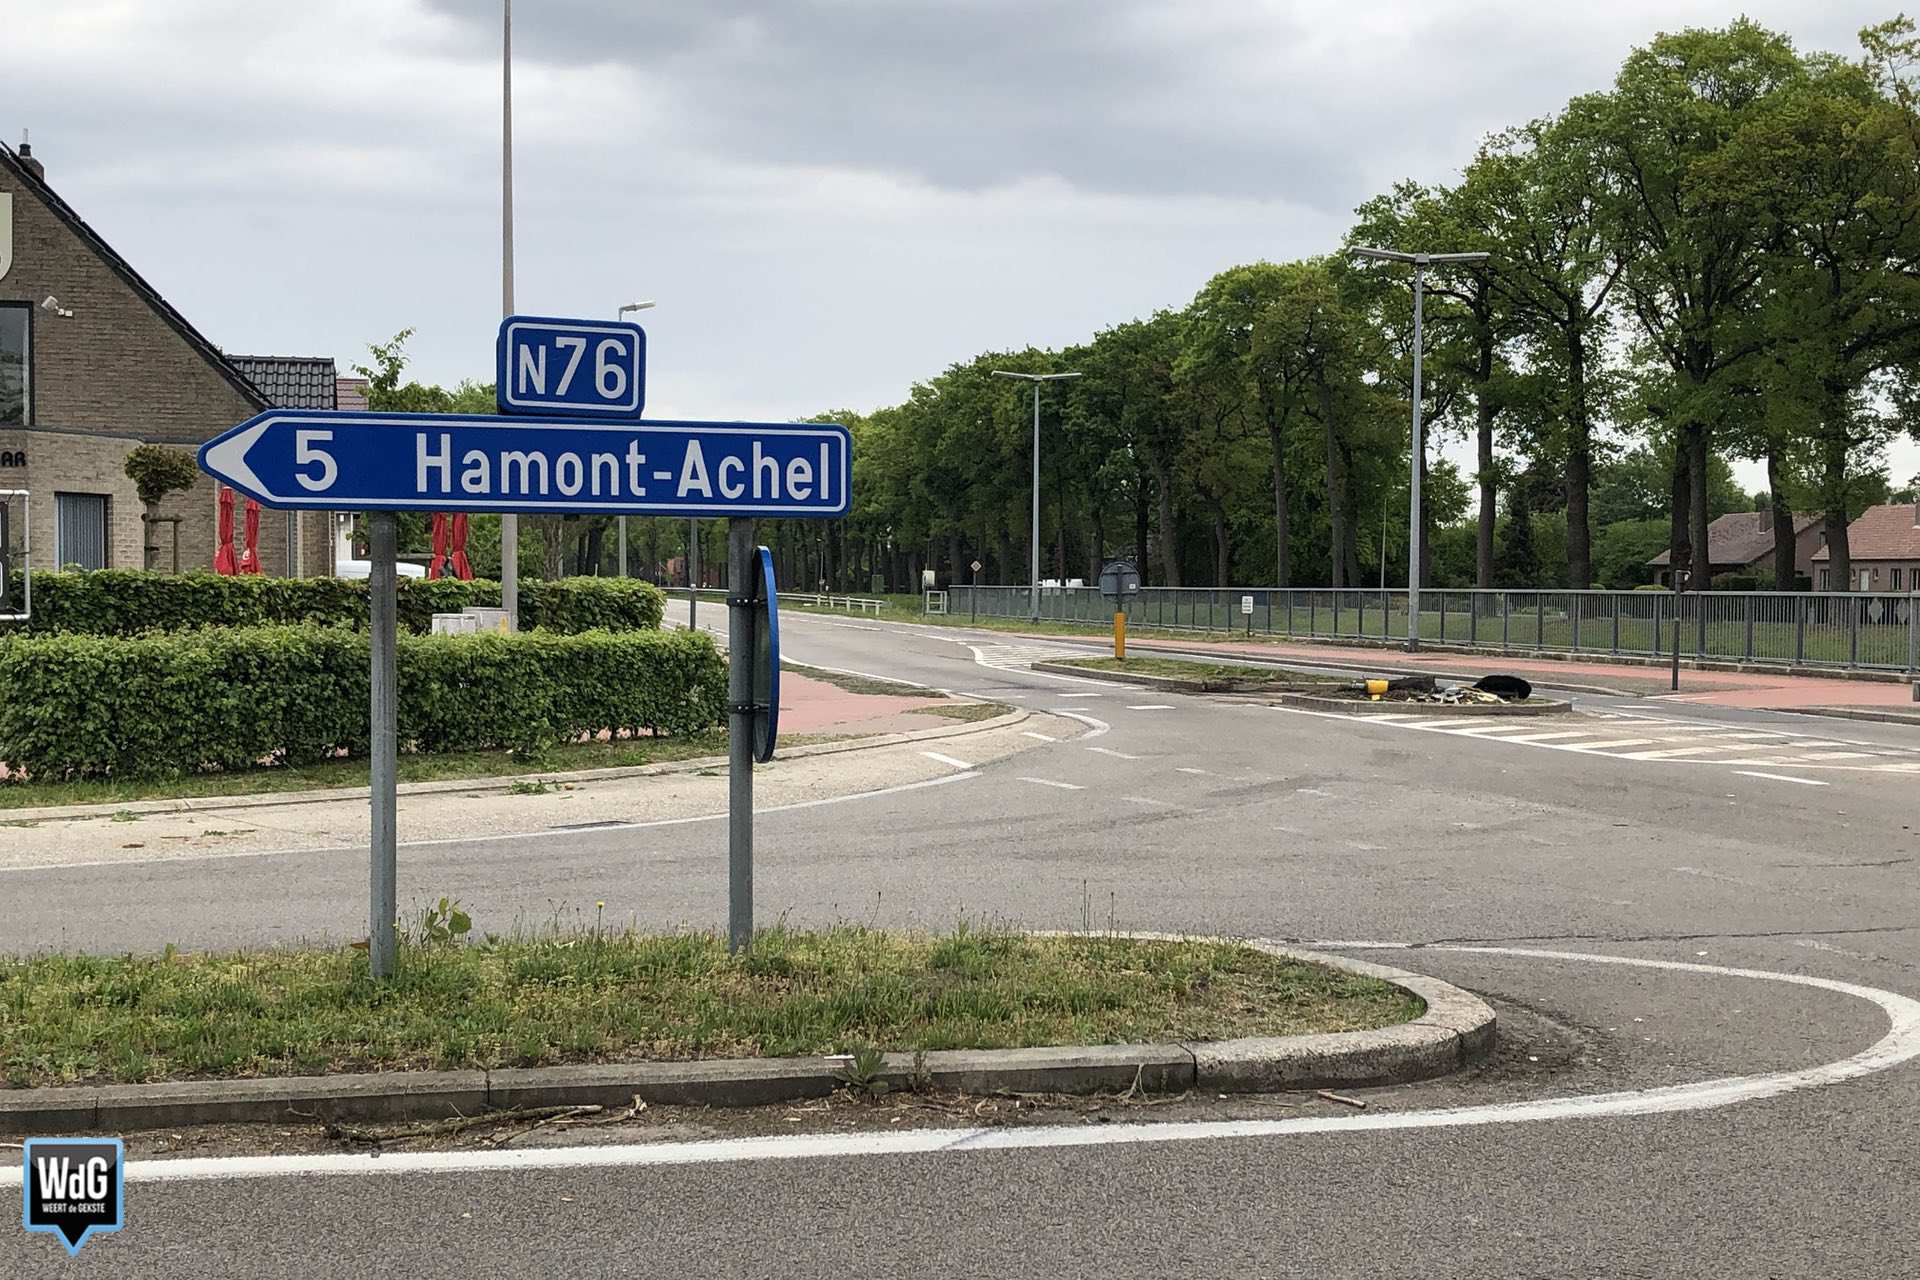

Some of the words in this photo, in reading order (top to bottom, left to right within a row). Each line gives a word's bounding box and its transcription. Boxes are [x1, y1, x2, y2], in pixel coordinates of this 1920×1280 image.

[518, 337, 628, 399] N76
[294, 429, 338, 491] 5
[415, 432, 831, 501] Hamont-Achel
